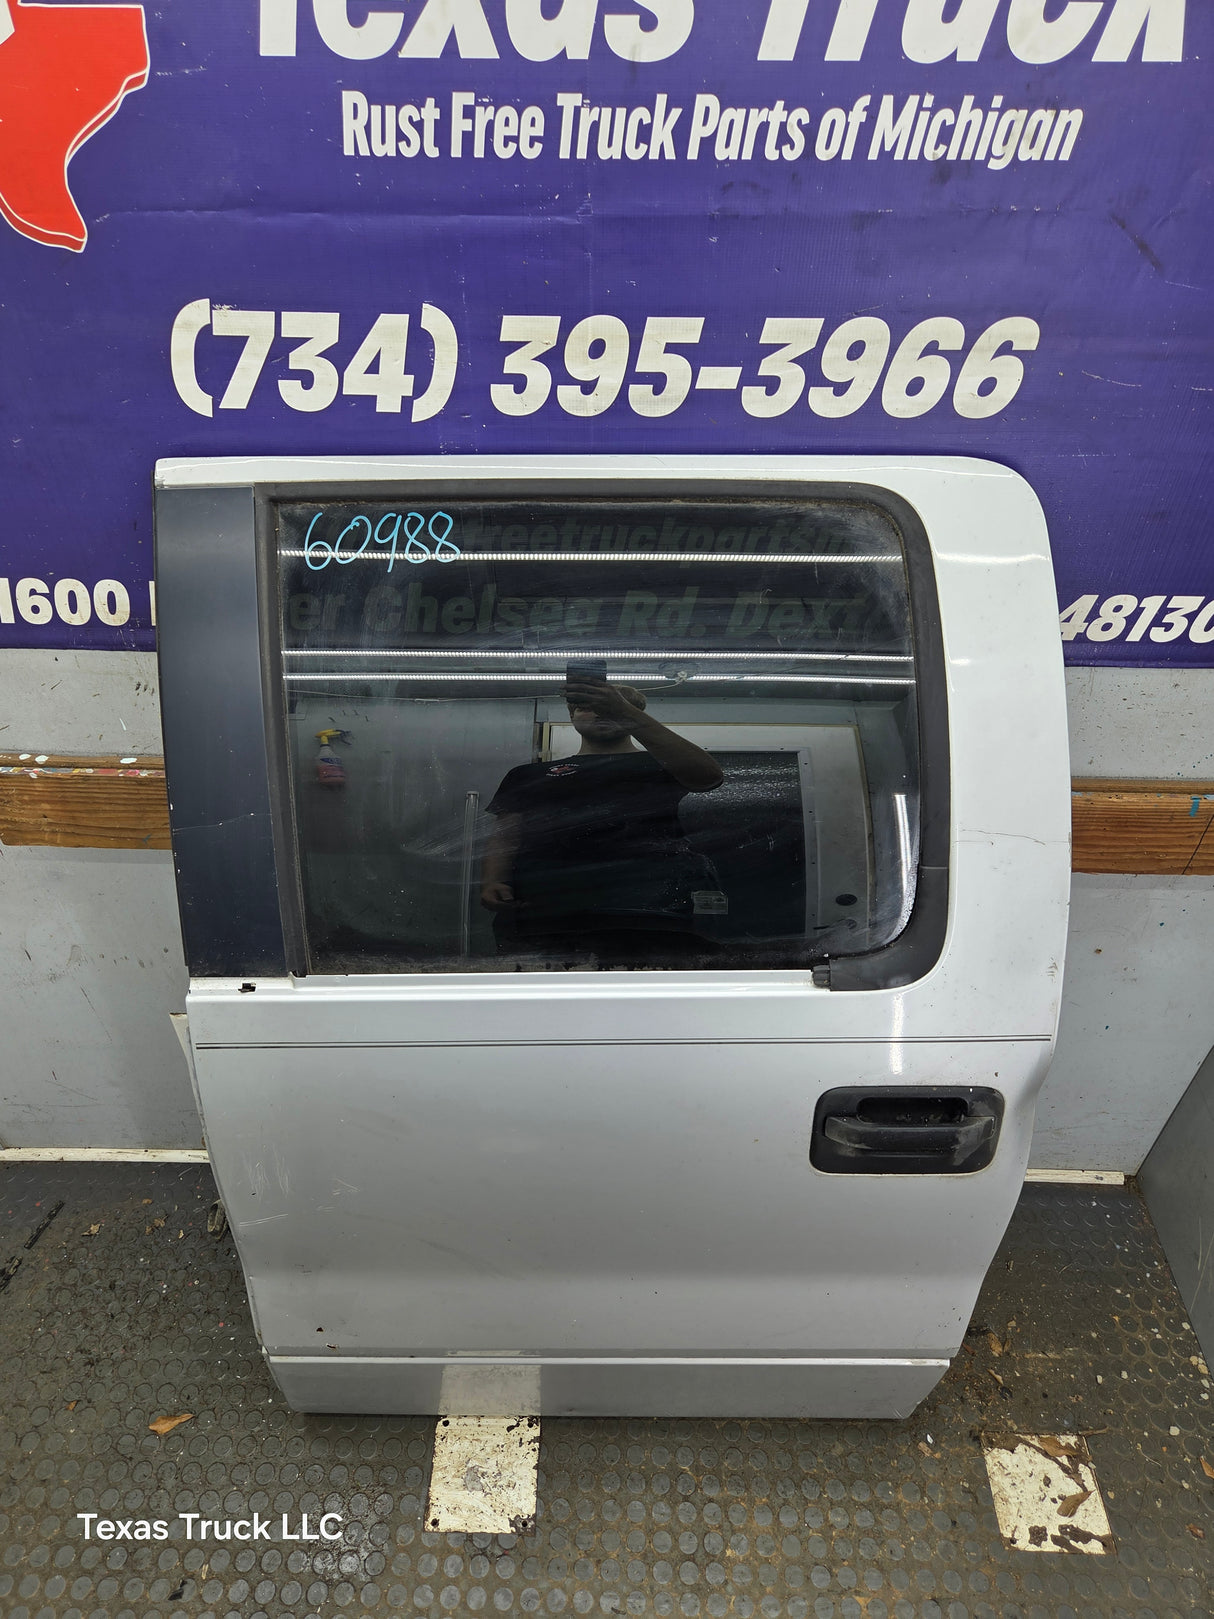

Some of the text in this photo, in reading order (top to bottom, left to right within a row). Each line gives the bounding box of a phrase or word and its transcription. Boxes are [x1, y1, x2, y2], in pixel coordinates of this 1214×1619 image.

[341, 91, 1083, 171] Rust Free Truck Parts of Michigan
[170, 298, 1040, 423] (734) 395-3966
[304, 511, 461, 573] 60988
